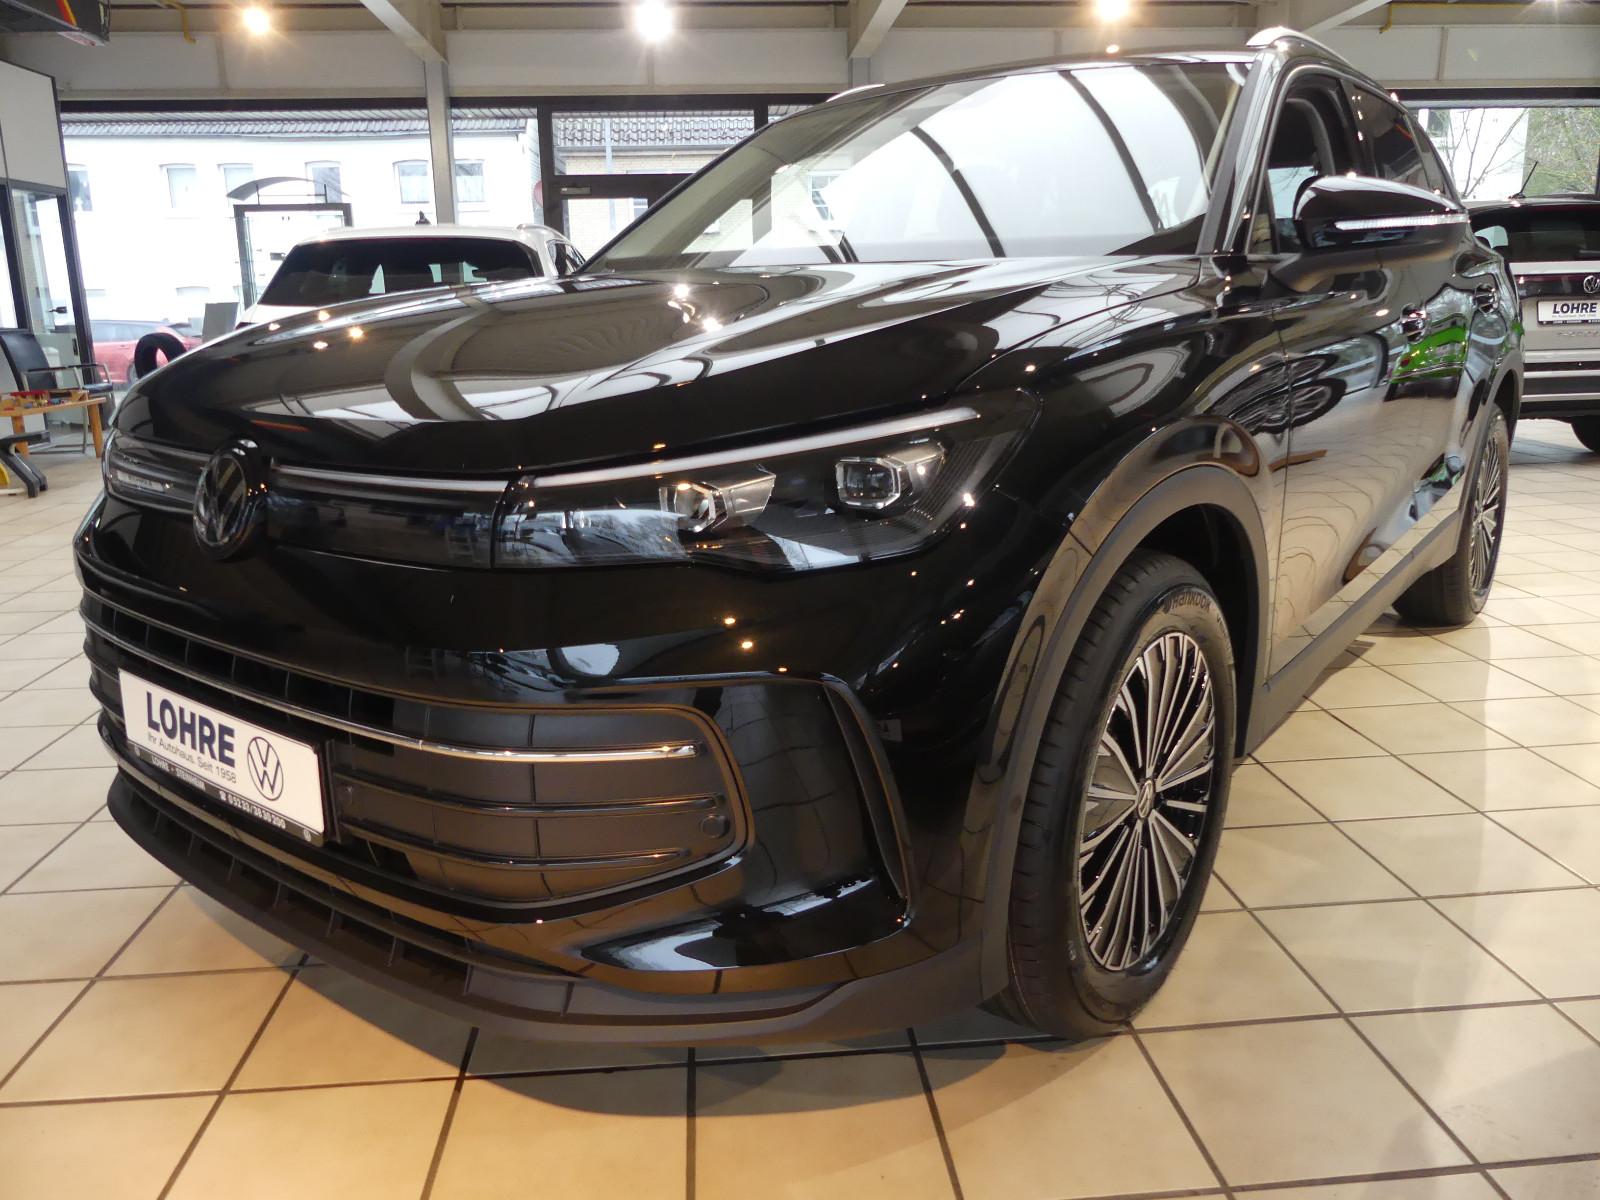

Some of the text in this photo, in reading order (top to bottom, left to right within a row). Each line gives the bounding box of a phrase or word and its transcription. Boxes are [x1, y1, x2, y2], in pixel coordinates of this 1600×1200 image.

[1553, 303, 1597, 314] LOHRE
[146, 691, 236, 768] LOHRE
[148, 732, 157, 744] Ihr
[197, 756, 214, 774] Seit
[215, 765, 237, 784] 1958
